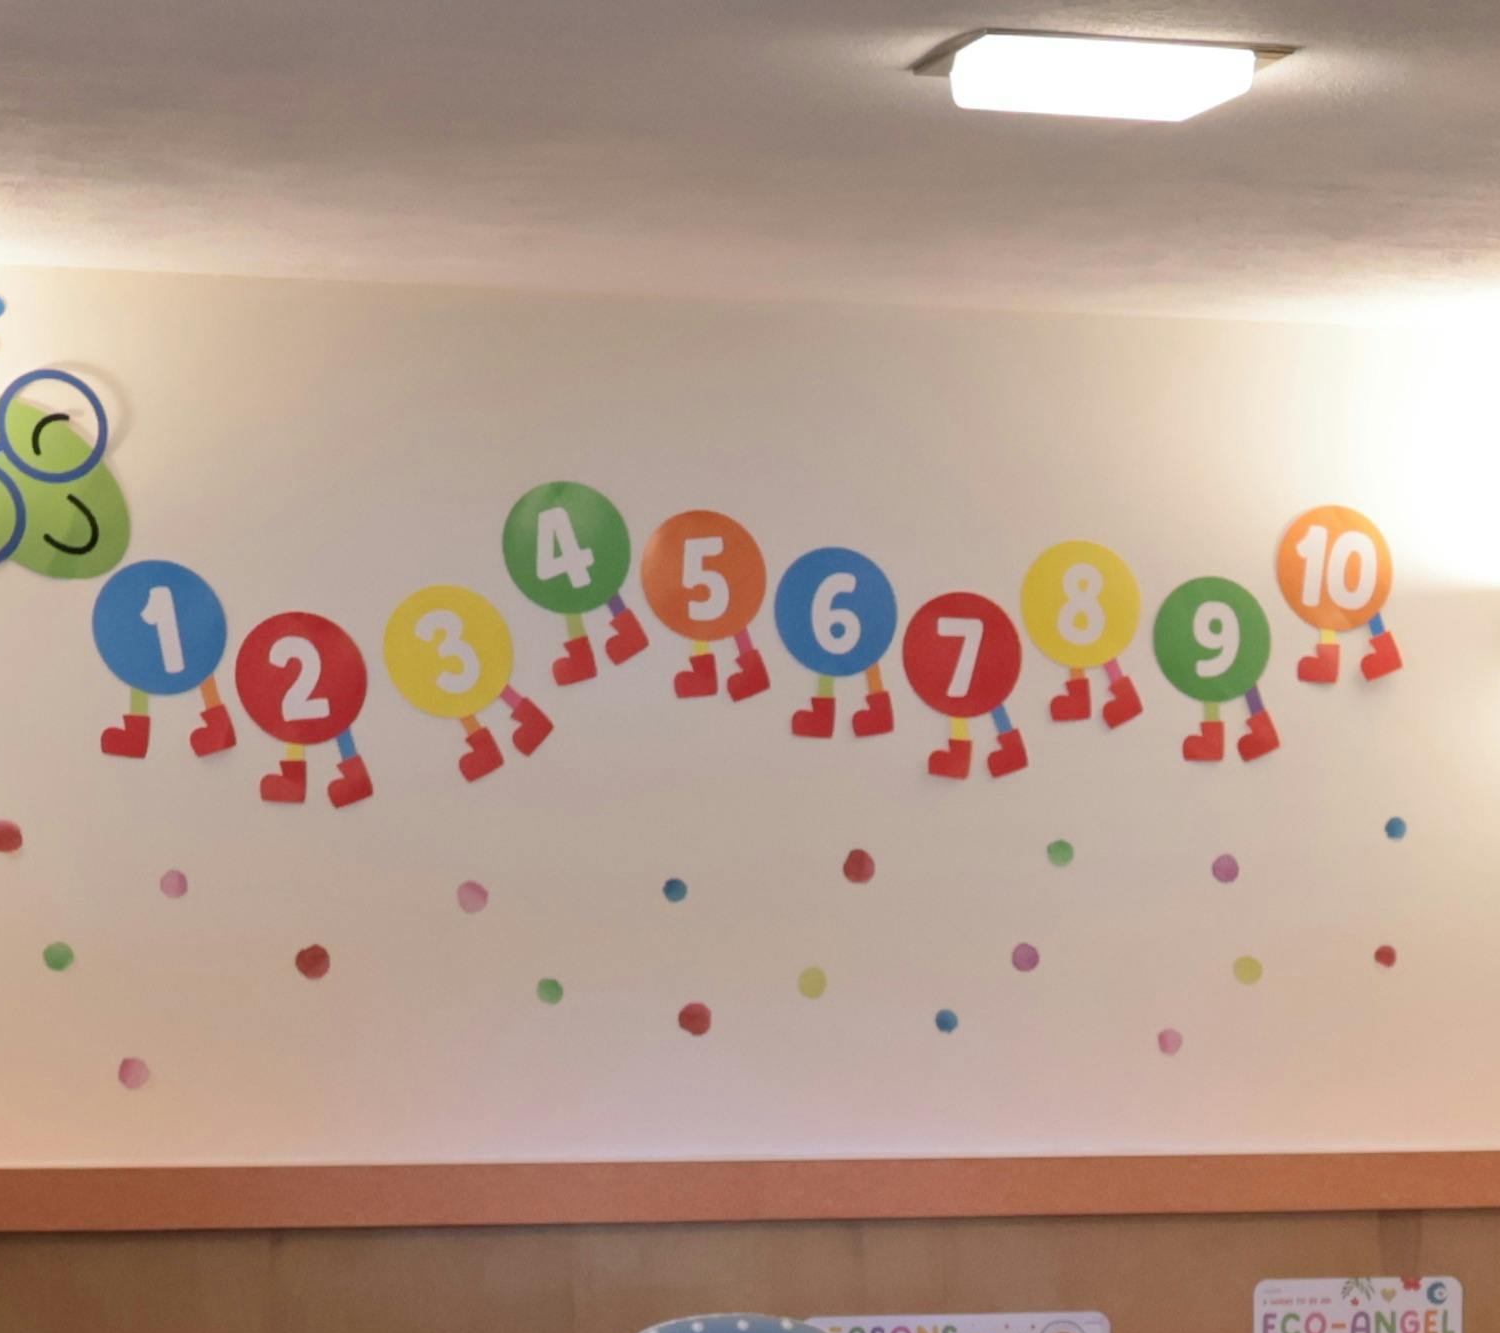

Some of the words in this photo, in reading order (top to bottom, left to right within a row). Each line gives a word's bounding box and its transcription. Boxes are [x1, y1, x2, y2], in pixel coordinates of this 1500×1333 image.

[536, 506, 594, 588] 4
[682, 536, 730, 621] 5
[1298, 525, 1377, 612] 10
[140, 586, 185, 674] 1
[811, 572, 862, 655] 6
[1057, 562, 1106, 645] 8
[1193, 601, 1240, 677] 9
[269, 635, 330, 722] 2
[414, 609, 481, 694] 3
[937, 617, 984, 698] 7
